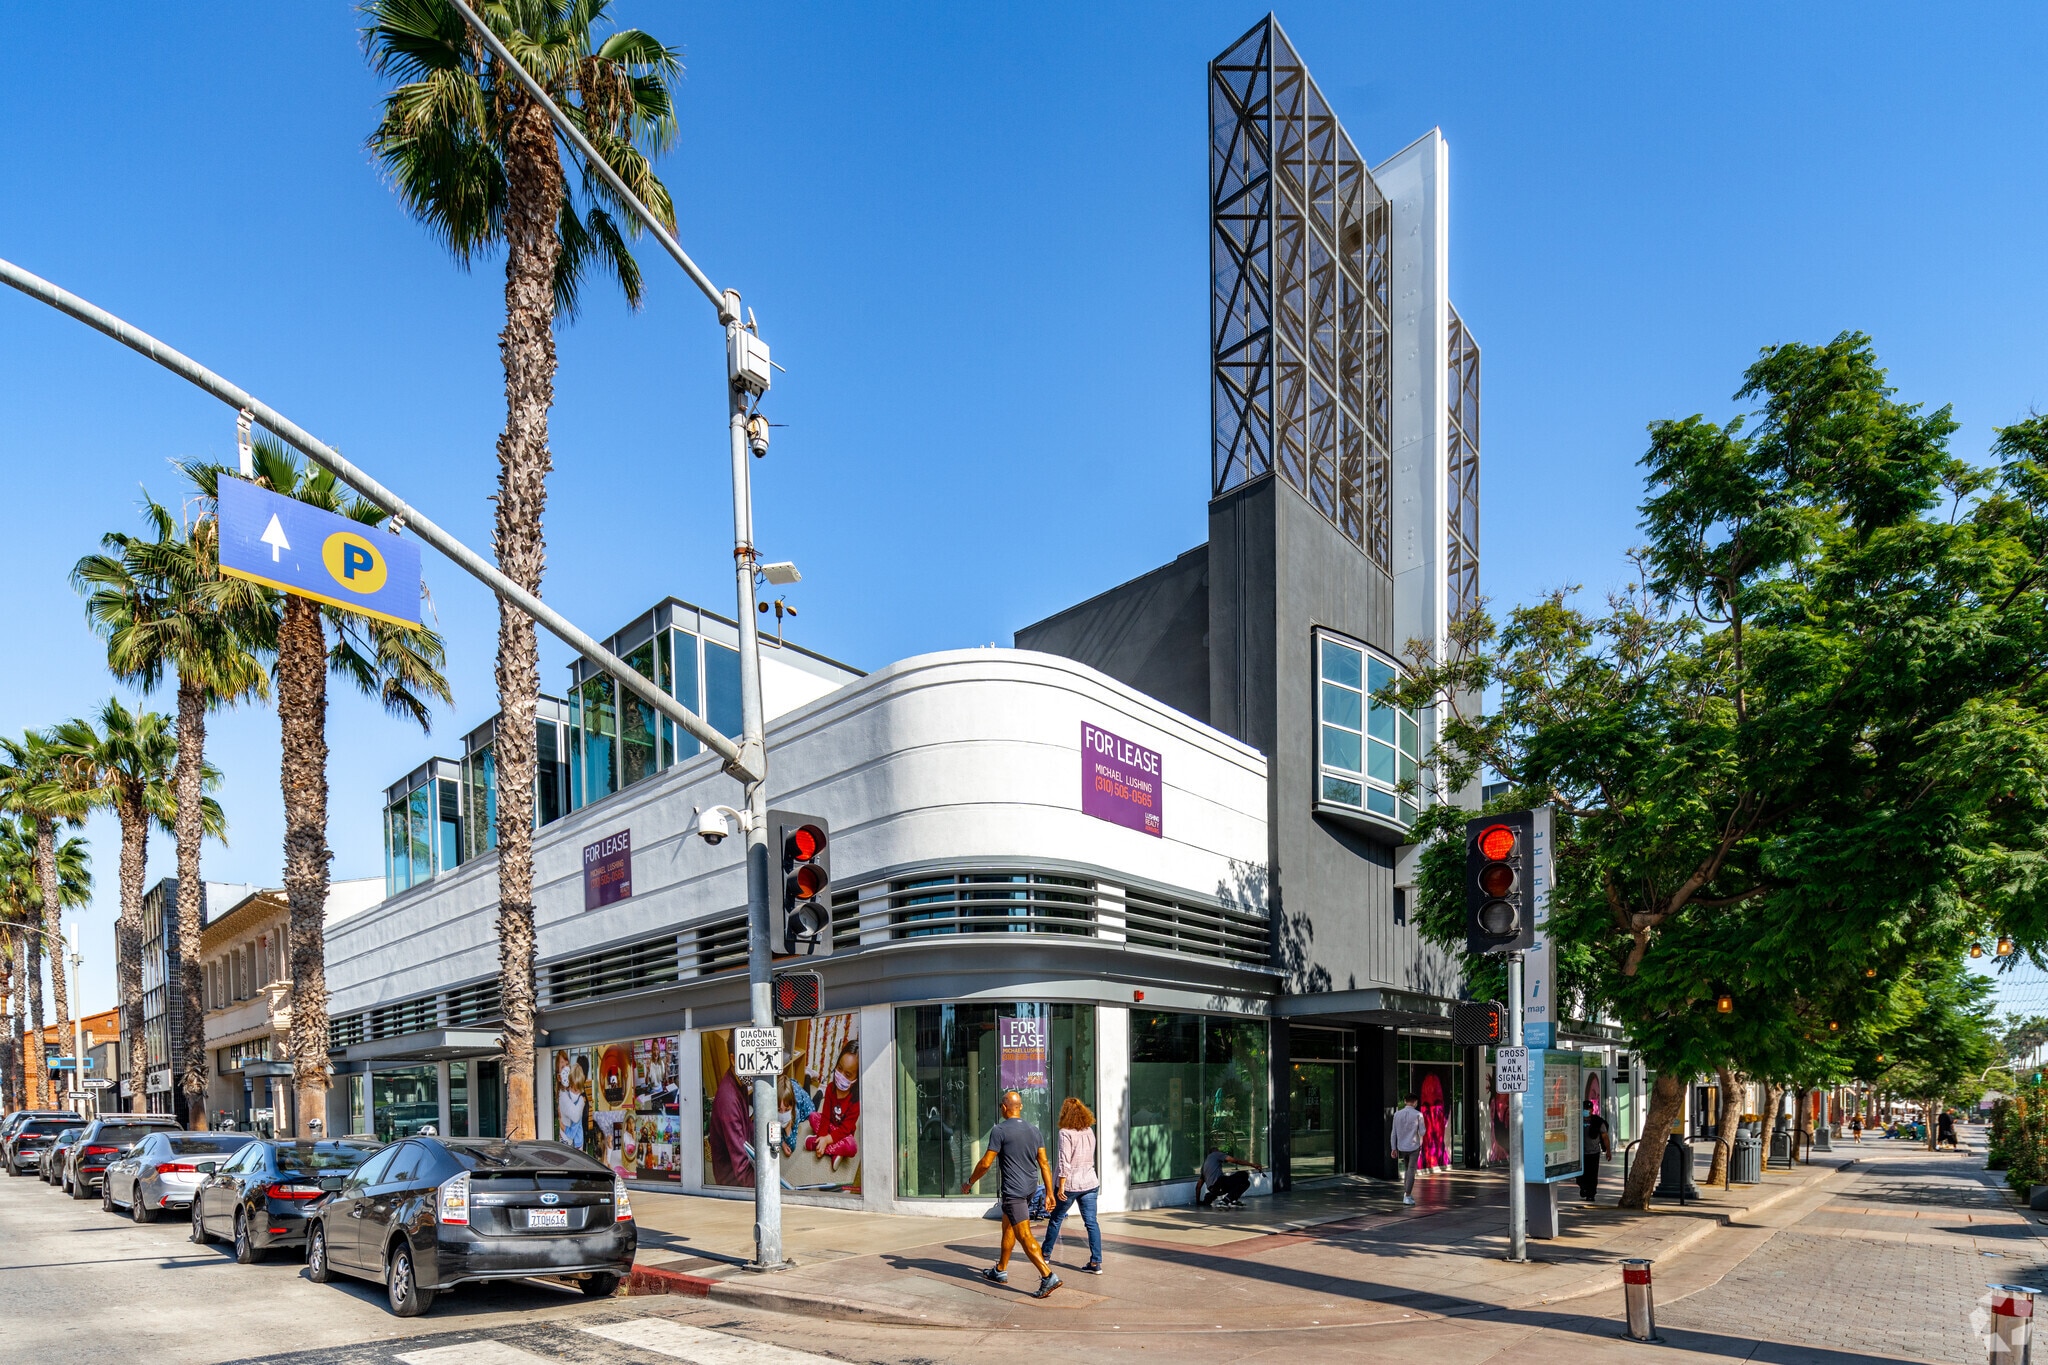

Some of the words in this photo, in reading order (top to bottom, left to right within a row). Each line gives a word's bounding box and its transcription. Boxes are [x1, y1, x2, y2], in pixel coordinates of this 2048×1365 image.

[344, 542, 373, 580] P
[1086, 726, 1114, 758] FOR
[1117, 739, 1159, 776] LEASE
[1095, 763, 1123, 783] MICHAEL
[1126, 775, 1152, 793] LUSHING
[1095, 776, 1114, 797] (310)
[1114, 783, 1152, 808] 505-0565
[585, 844, 600, 864] FOR
[601, 832, 629, 857] LEASE
[1531, 831, 1543, 953] WLSHIRE
[1533, 979, 1540, 997] i
[1527, 1005, 1546, 1014] map
[1010, 1021, 1036, 1034] FOR
[1488, 1011, 1498, 1038] 3
[740, 1030, 777, 1038] DIAGONAL
[1002, 1034, 1045, 1048] LEASE
[741, 1039, 777, 1047] CROSSING
[1499, 1049, 1525, 1057] CROSS
[738, 1052, 755, 1071] OK
[1501, 1065, 1522, 1073] WALK
[1498, 1074, 1526, 1082] SIGNAL
[1502, 1082, 1522, 1090] ONLY
